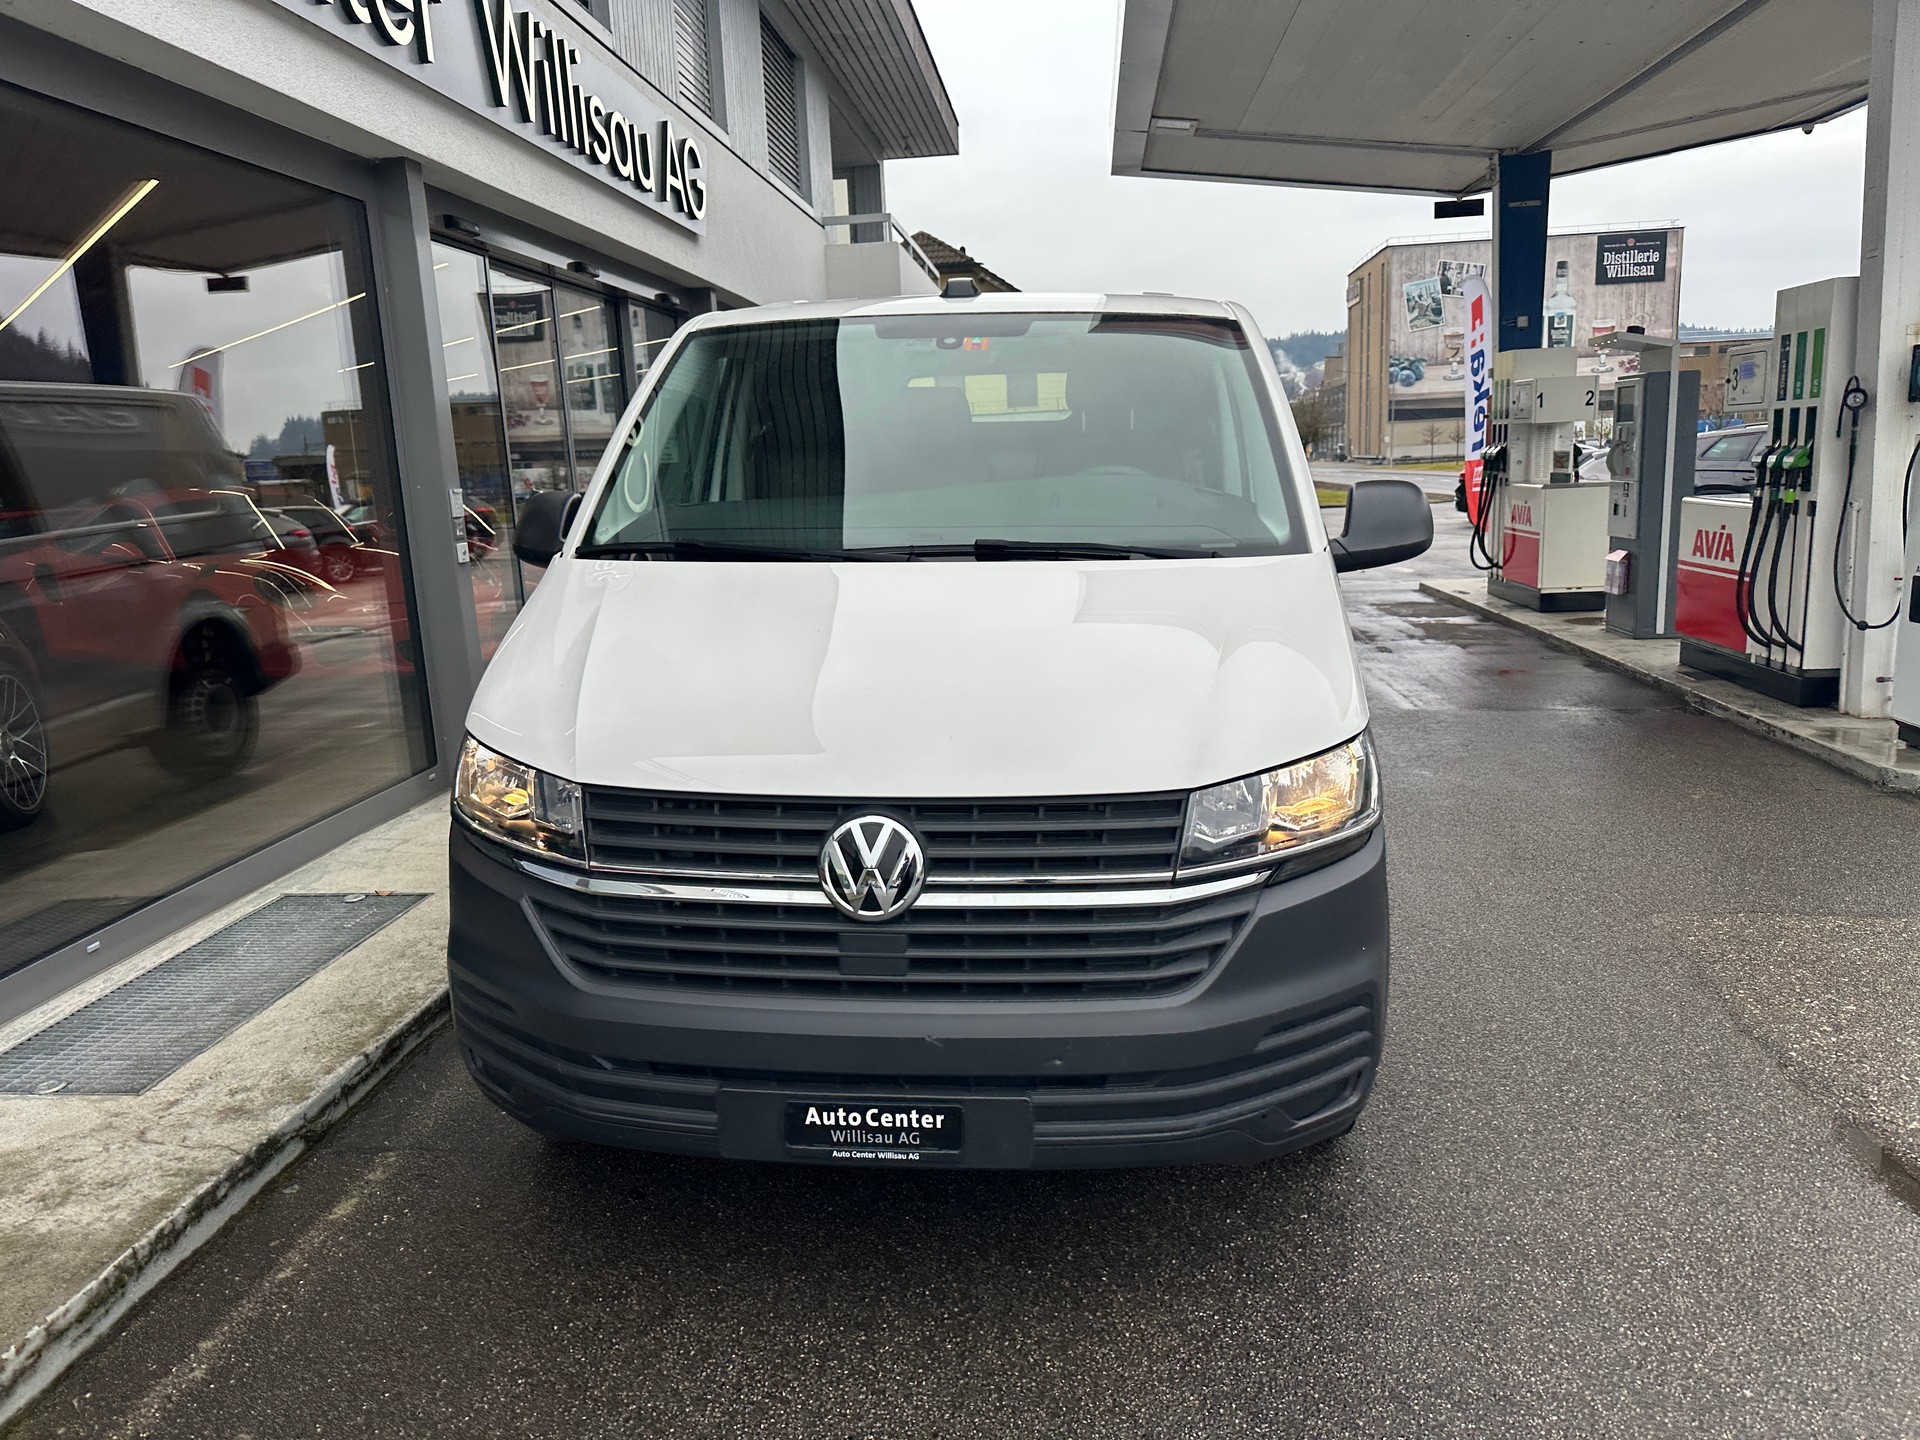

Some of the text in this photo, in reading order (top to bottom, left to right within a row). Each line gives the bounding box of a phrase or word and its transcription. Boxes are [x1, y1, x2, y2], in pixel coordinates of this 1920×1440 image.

[475, 0, 656, 192] Willisau
[660, 120, 707, 221] AG
[1603, 249, 1660, 265] Distillerie
[1605, 264, 1655, 278] Willisau
[1731, 368, 1738, 391] 3
[1537, 392, 1543, 408] 1
[1585, 390, 1594, 406] 2
[1511, 501, 1532, 527] AVIA
[1691, 525, 1735, 563] AVIA
[805, 1107, 944, 1128] Auto Center
[831, 1129, 920, 1145] Willisau AG
[832, 1150, 850, 1158] Auto
[852, 1151, 876, 1159] Center
[877, 1151, 907, 1160] Willisau
